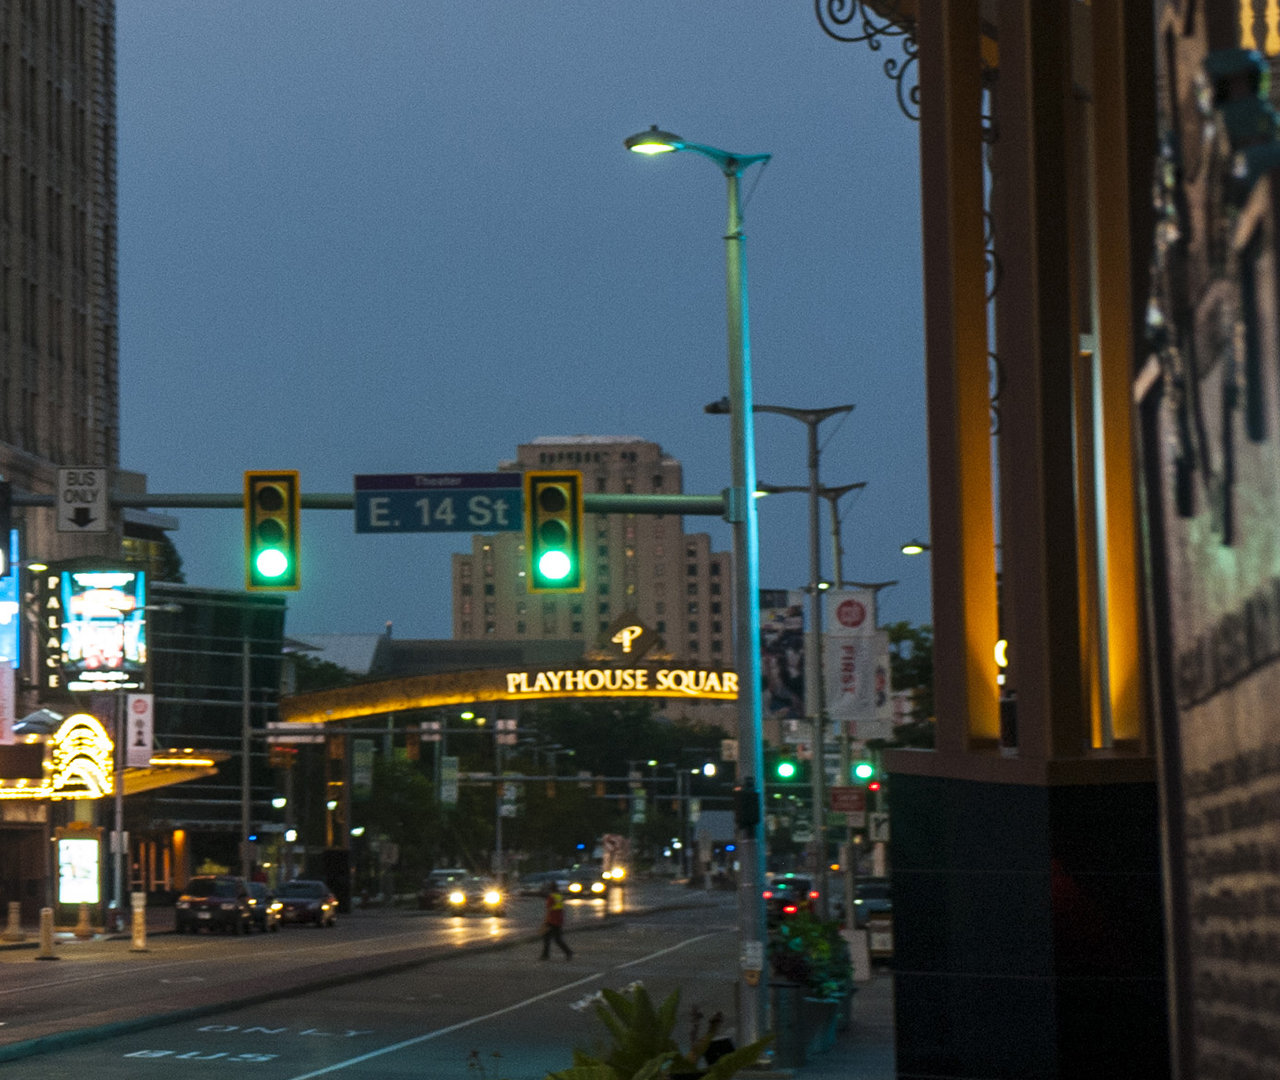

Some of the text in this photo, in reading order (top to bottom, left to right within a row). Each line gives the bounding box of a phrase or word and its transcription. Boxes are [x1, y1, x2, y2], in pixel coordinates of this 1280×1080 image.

[66, 471, 96, 486] BUS
[63, 489, 99, 504] ONLY
[369, 495, 509, 527] E. 14 St
[46, 575, 62, 690] PALACE
[506, 669, 739, 695] PLAYHOUSE SQUAR
[197, 1024, 375, 1038] ONLY
[122, 1048, 281, 1063] BUS
